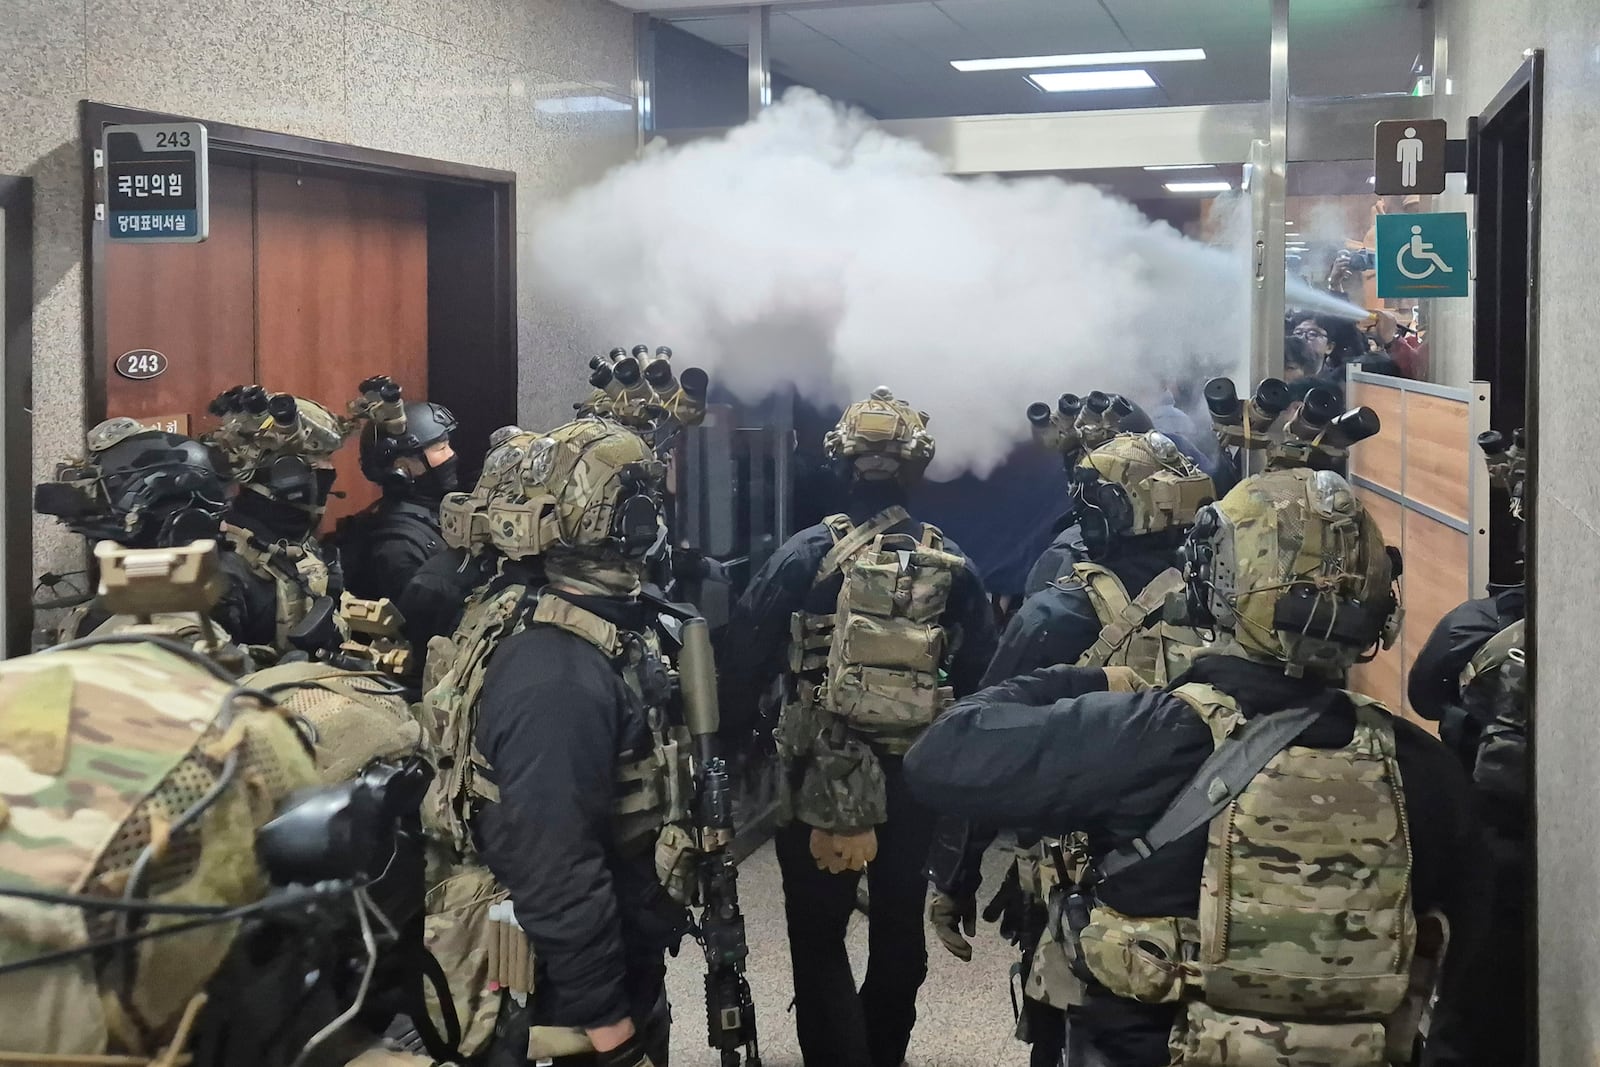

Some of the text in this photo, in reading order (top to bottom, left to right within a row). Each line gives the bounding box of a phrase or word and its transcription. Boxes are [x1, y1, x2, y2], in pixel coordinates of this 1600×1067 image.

[155, 131, 191, 148] 243
[118, 173, 182, 197] 국민의힘
[117, 215, 186, 232] 당대표비서실
[128, 354, 158, 373] 243
